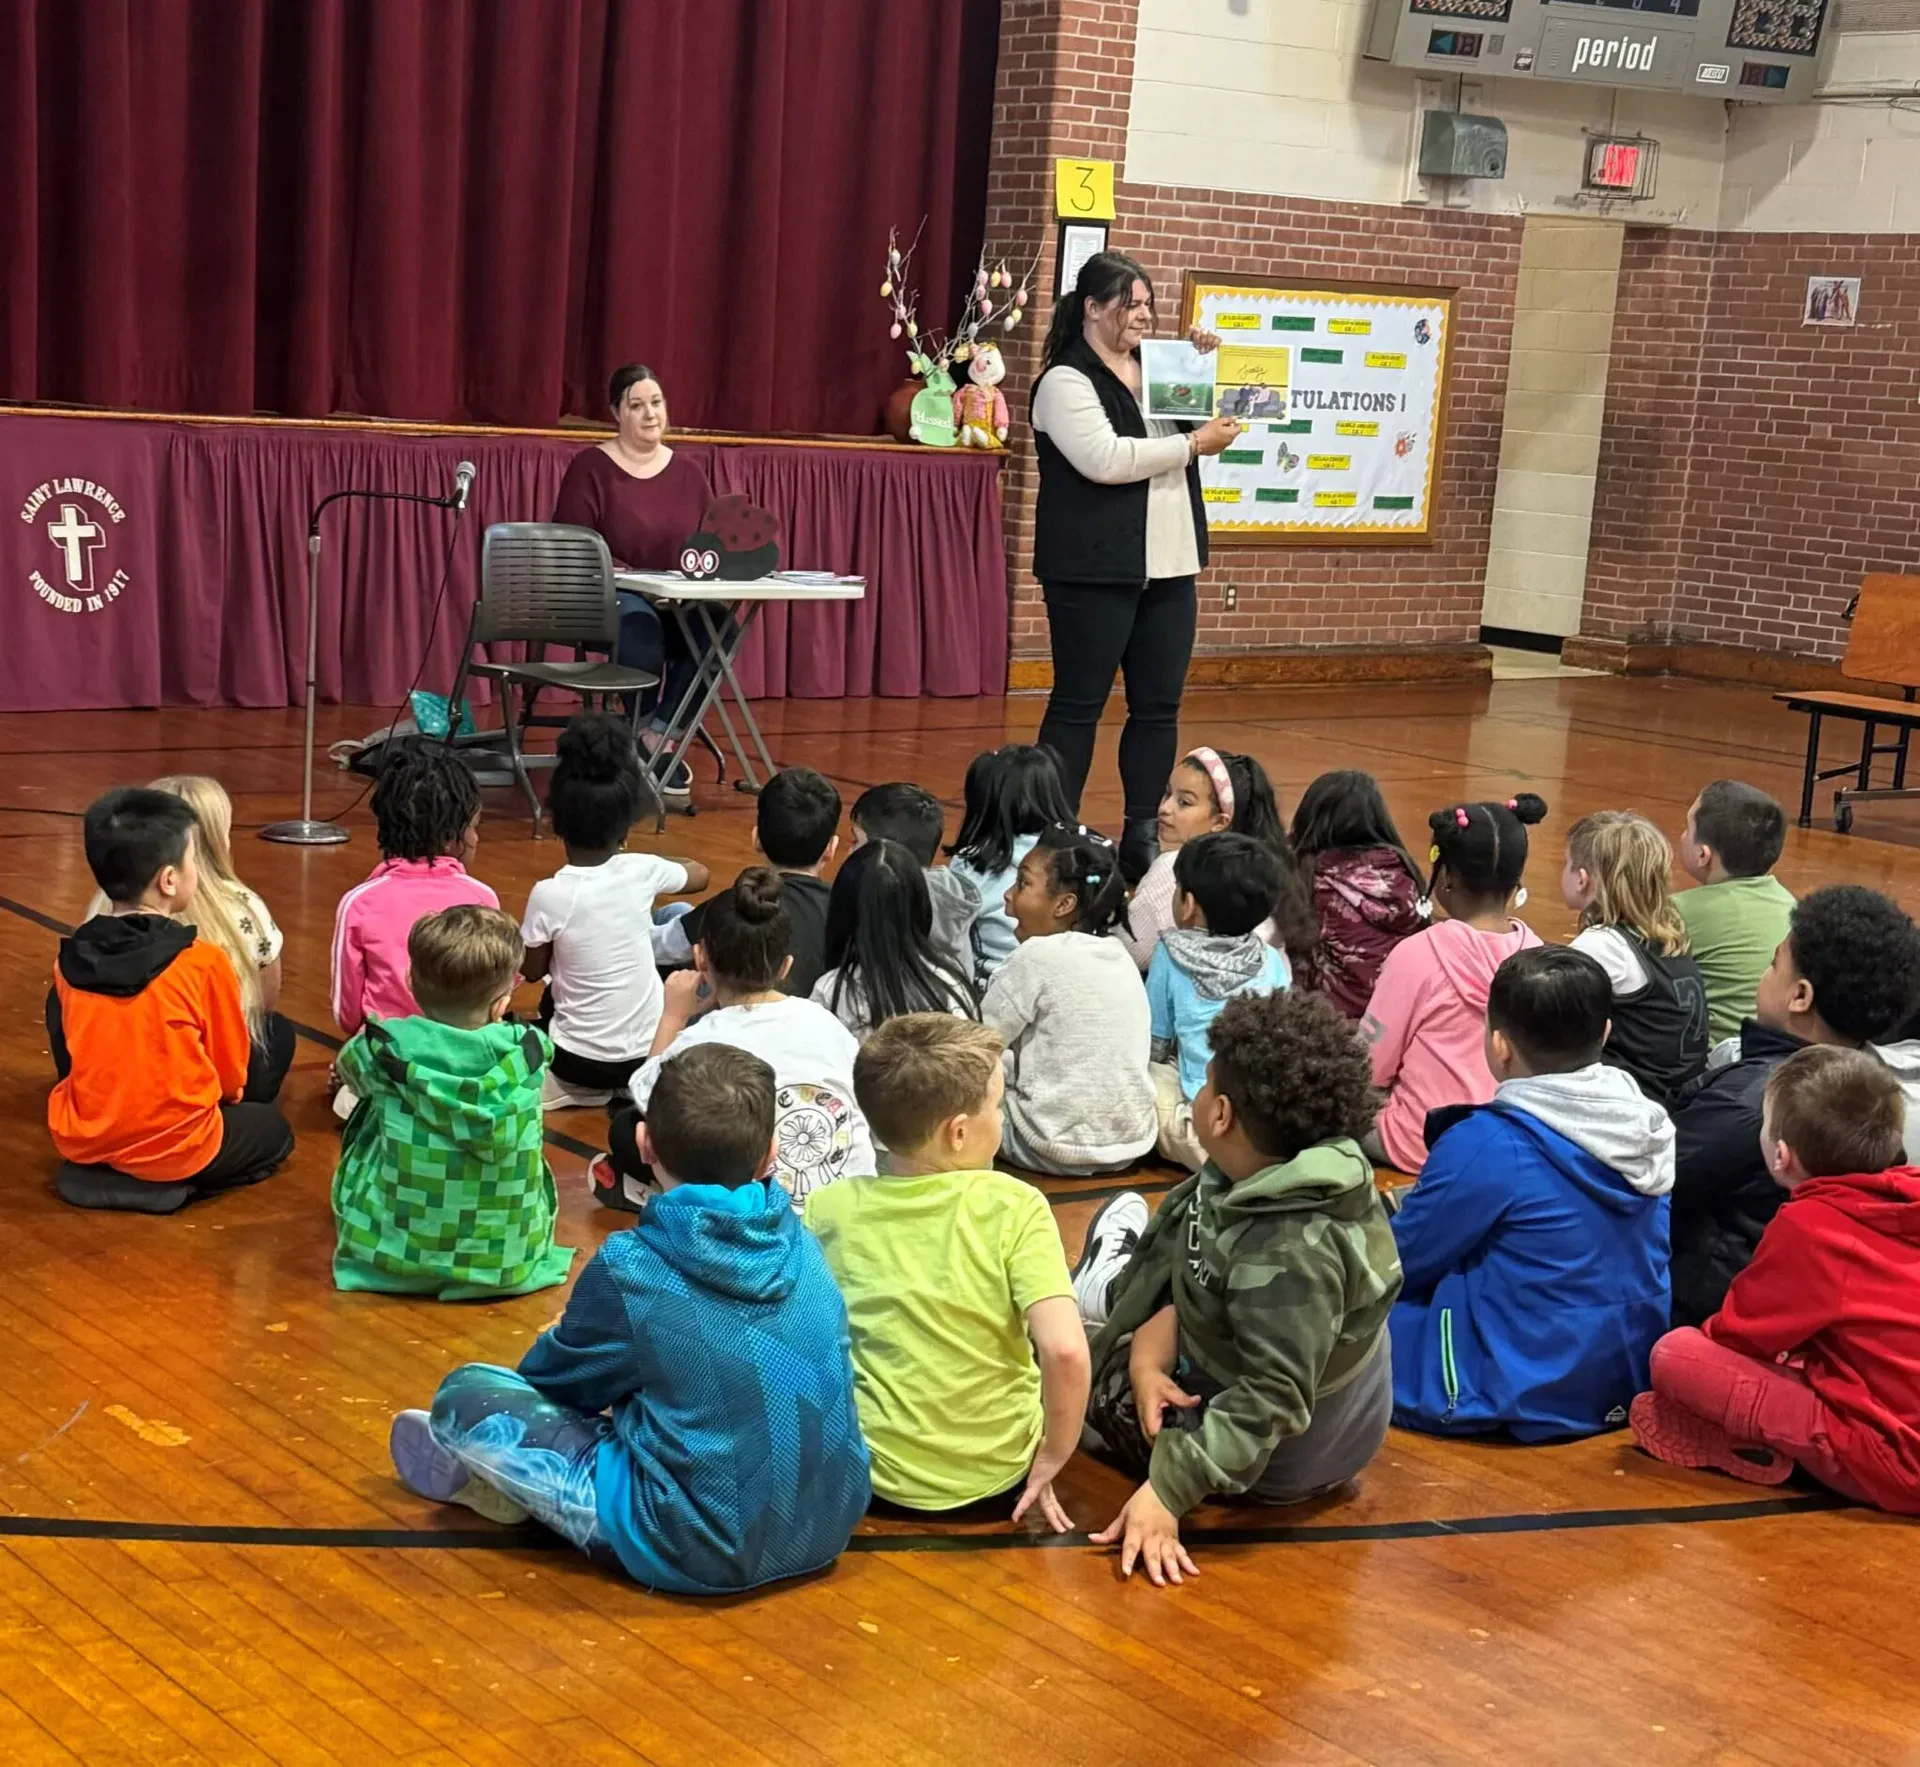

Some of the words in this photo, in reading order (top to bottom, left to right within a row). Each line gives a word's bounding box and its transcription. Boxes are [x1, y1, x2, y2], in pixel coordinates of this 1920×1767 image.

[1571, 35, 1658, 73] period
[1070, 166, 1096, 212] 3
[20, 482, 53, 524] SAINT
[52, 477, 127, 524] LAWRENCE
[28, 570, 83, 613] FOUNDED
[86, 593, 105, 613] IN
[103, 568, 131, 602] 1917
